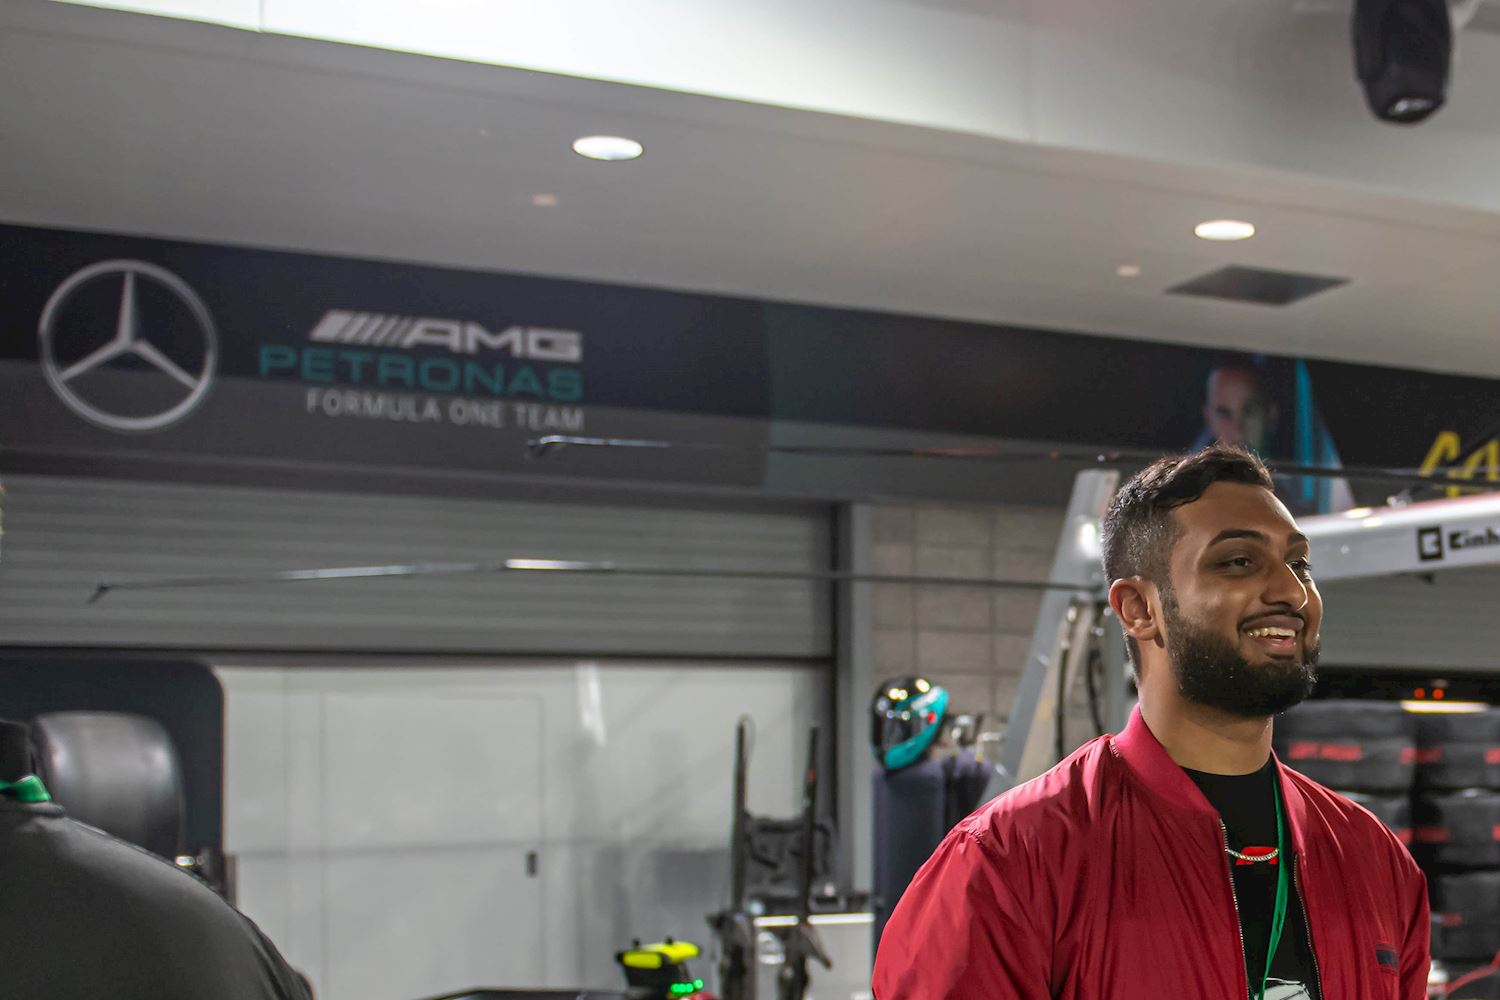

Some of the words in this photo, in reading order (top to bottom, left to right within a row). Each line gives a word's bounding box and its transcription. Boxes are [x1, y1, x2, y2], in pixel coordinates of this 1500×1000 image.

[402, 318, 583, 363] AMG
[259, 343, 584, 400] PETRONAS
[307, 387, 441, 423] FORMULA
[449, 398, 501, 428] ONE
[512, 402, 584, 431] TEAM
